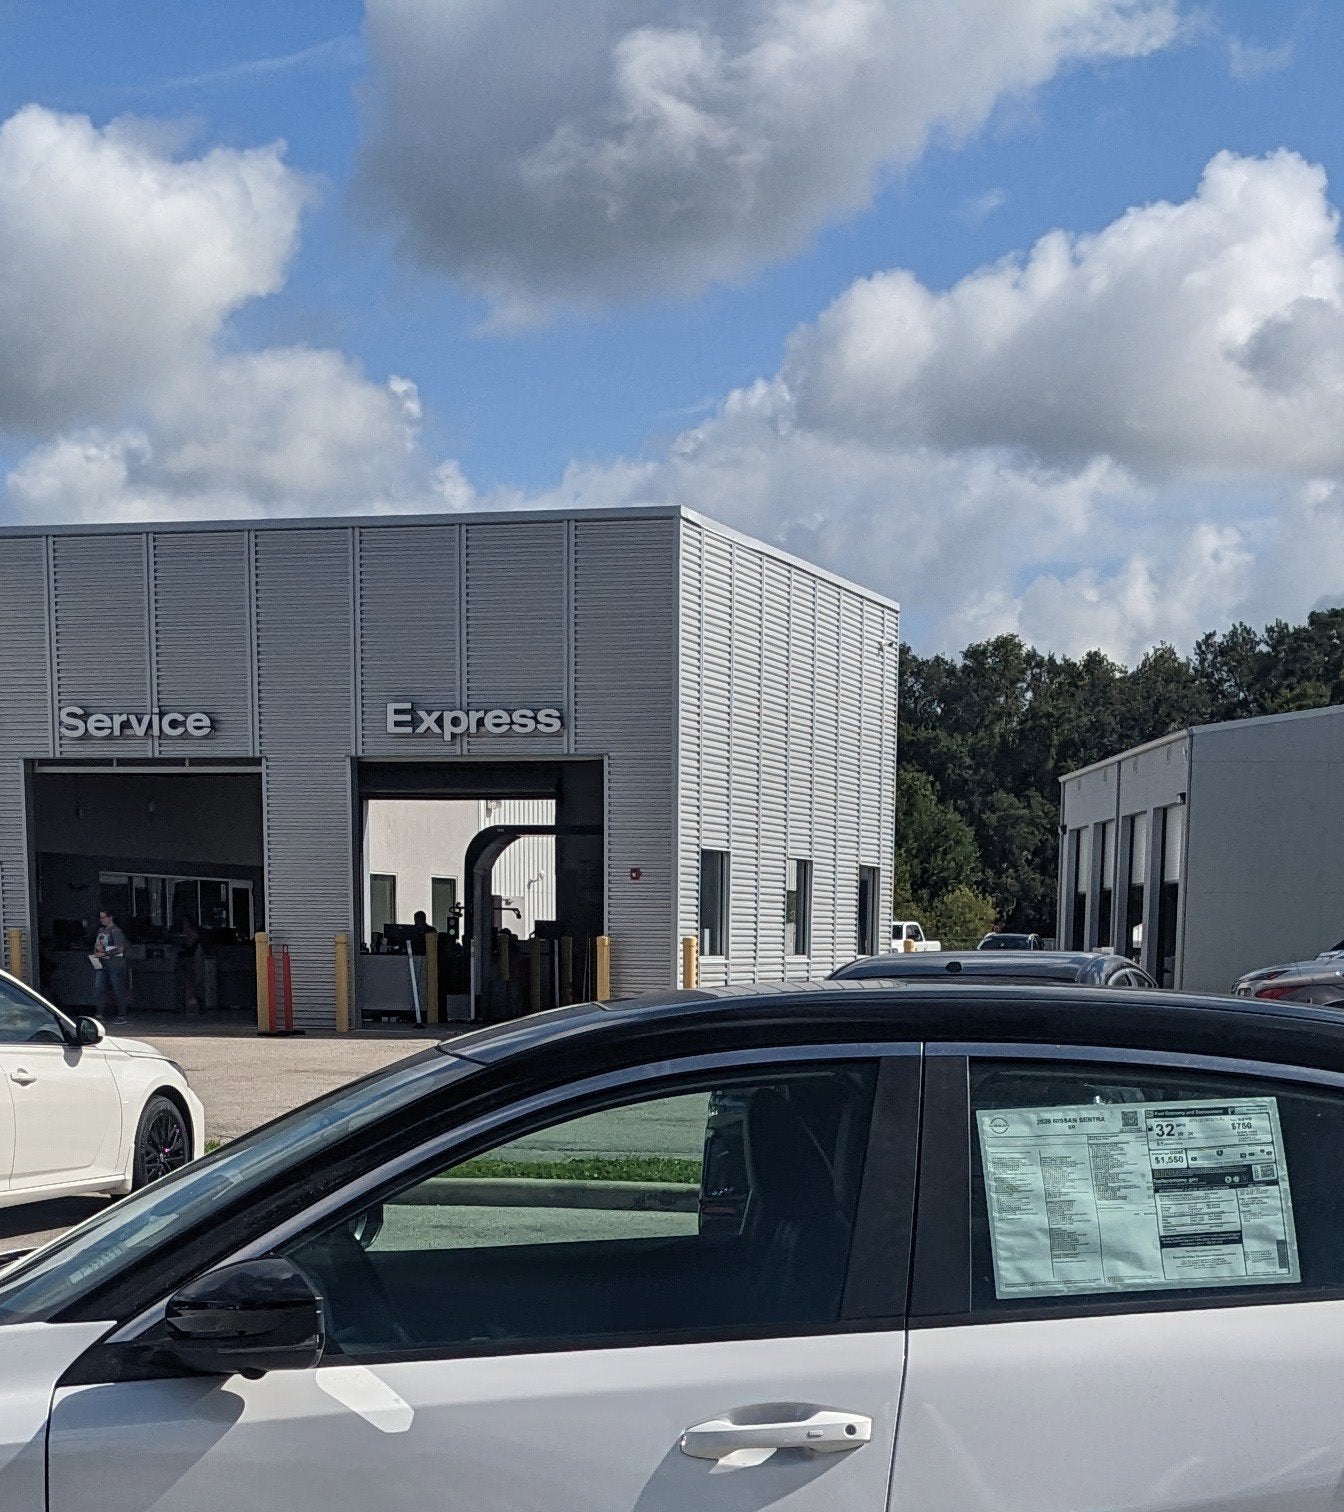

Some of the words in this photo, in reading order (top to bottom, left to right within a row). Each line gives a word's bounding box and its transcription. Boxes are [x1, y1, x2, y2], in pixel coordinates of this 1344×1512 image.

[59, 706, 212, 737] Service
[386, 702, 562, 742] Express
[1155, 1123, 1176, 1137] 32
